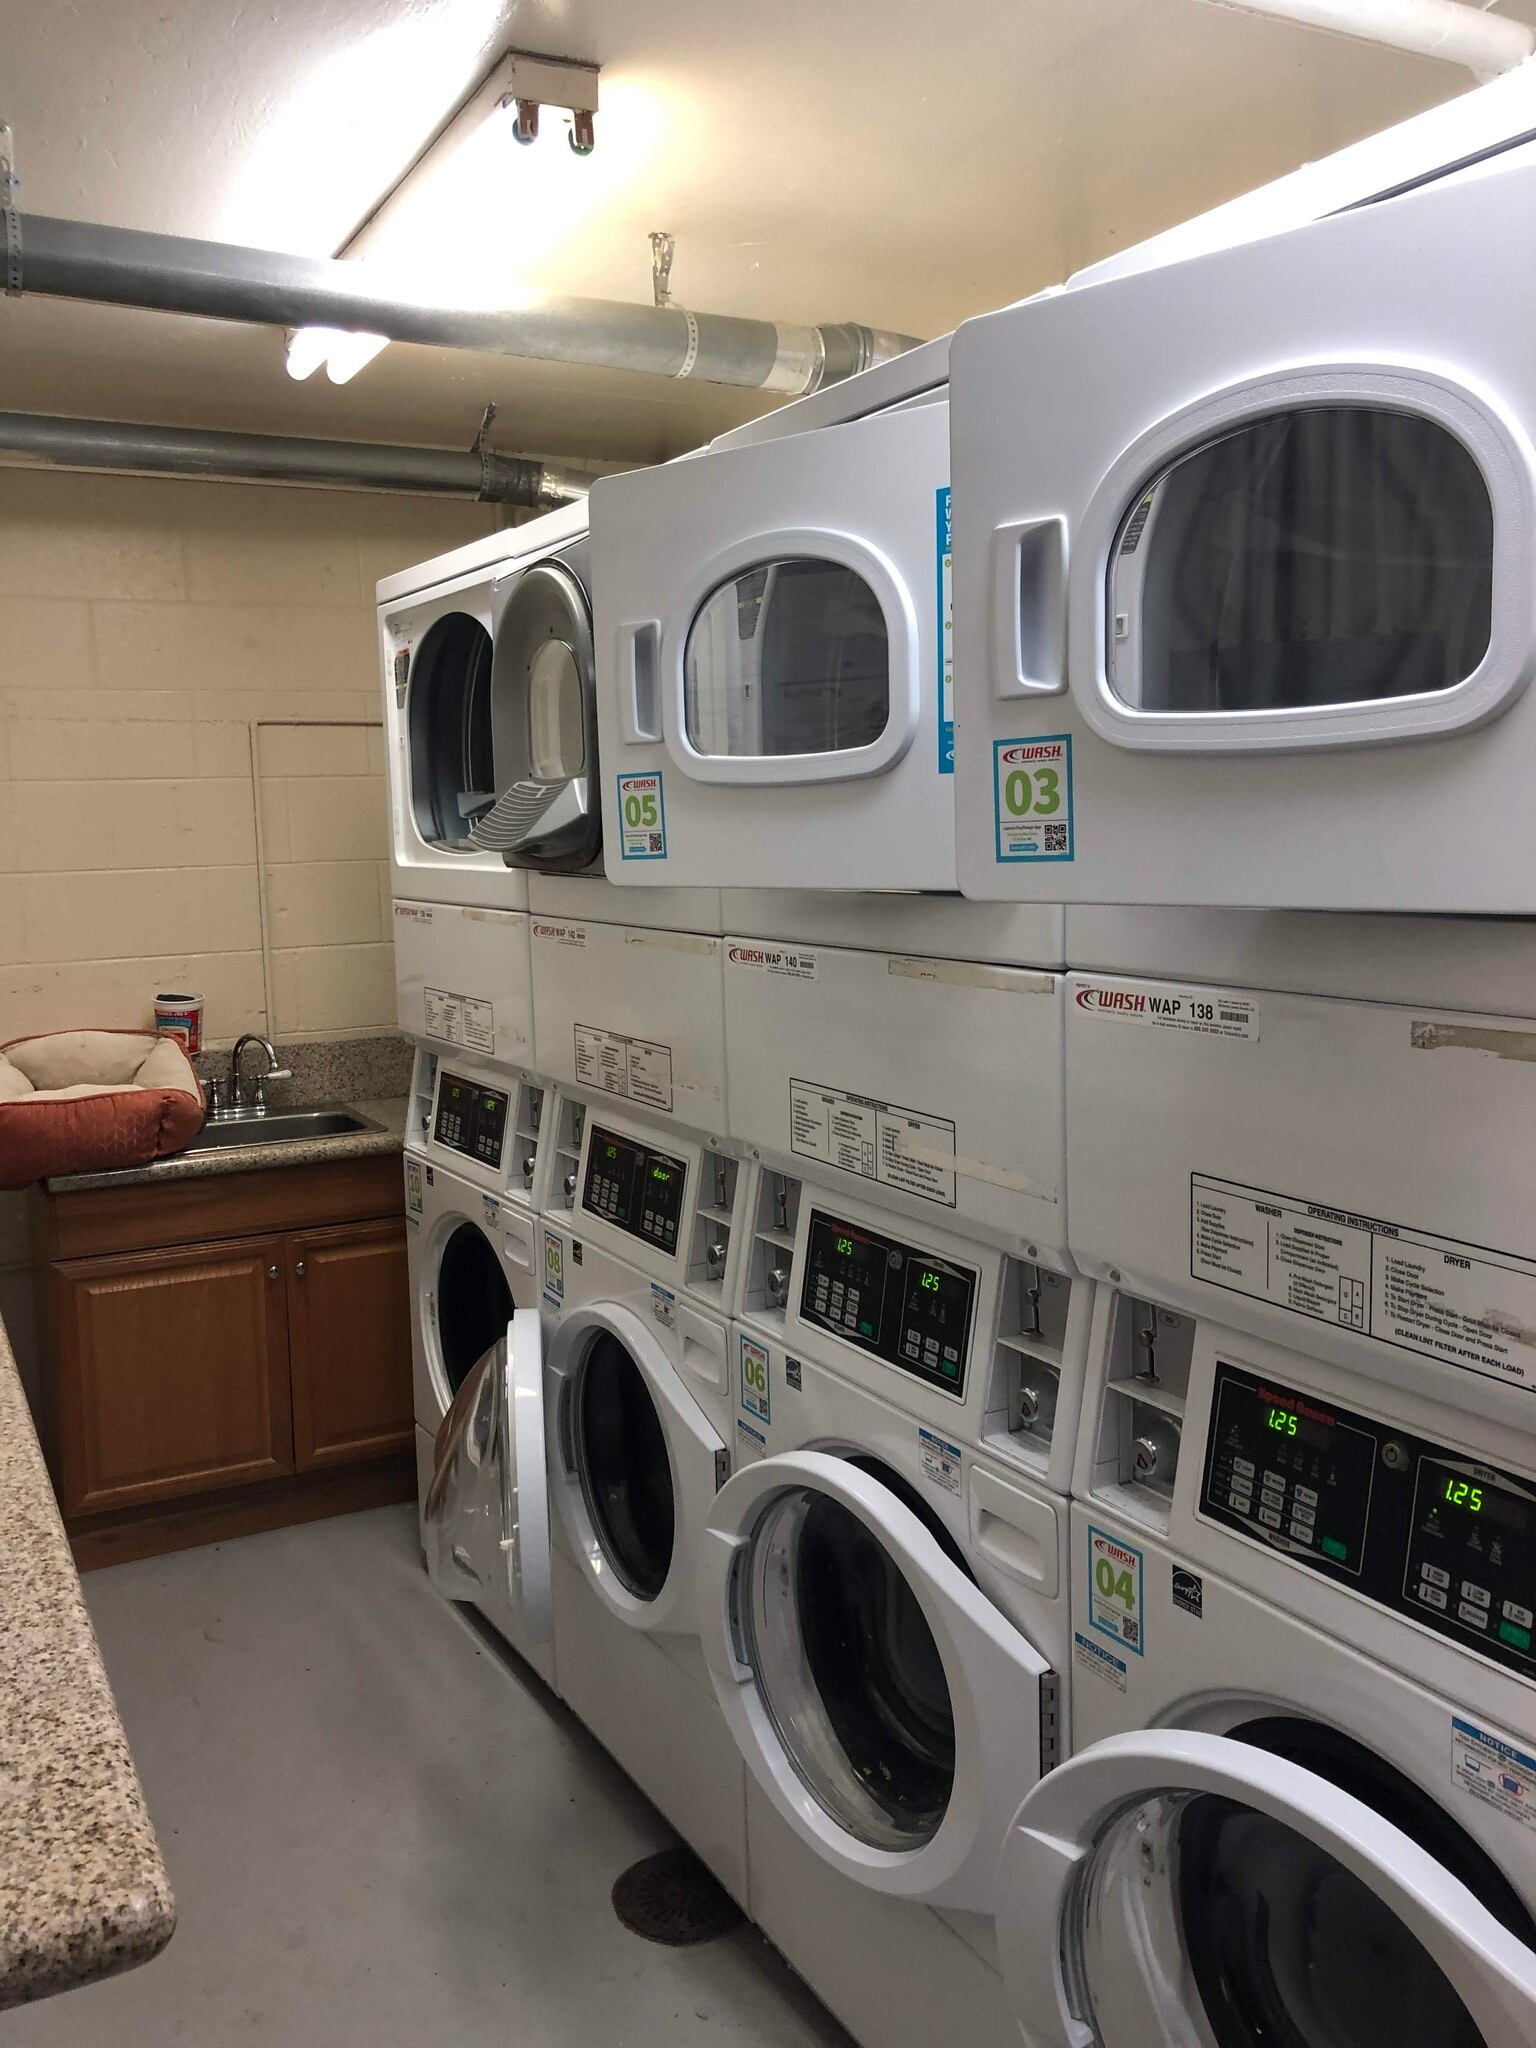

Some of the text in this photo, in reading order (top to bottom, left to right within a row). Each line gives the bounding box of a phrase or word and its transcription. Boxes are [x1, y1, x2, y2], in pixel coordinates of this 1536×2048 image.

[1022, 746, 1061, 760] WASH
[633, 779, 656, 789] WASH
[1005, 768, 1060, 816] 03
[625, 795, 657, 827] 05
[541, 926, 555, 936] WASH
[740, 949, 763, 963] WASH
[765, 953, 781, 965] WAP
[785, 956, 797, 967] 140
[1099, 991, 1145, 1011] WASH
[1149, 997, 1180, 1015] WAP
[1189, 1002, 1213, 1020] 138
[653, 1167, 670, 1181] door
[410, 1174, 419, 1195] 10
[1255, 1204, 1282, 1218] WASHER
[1308, 1206, 1399, 1236] OPERATING INSTRUCTIONS
[548, 1247, 560, 1274] 08
[1391, 1258, 1404, 1266] Load
[1404, 1261, 1426, 1273] Laundry
[1444, 1255, 1470, 1270] DRYER
[1390, 1267, 1405, 1276] Close
[1406, 1271, 1419, 1279] Door
[1390, 1276, 1404, 1284] Make
[1406, 1280, 1419, 1290] Cycle
[1420, 1284, 1445, 1296] Selection
[1390, 1285, 1404, 1294] Make
[1398, 1295, 1409, 1304] Start
[1411, 1298, 1424, 1309] Dryer
[1390, 1302, 1396, 1310] To
[1398, 1305, 1408, 1315] Stop
[1410, 1307, 1424, 1319] Dryer
[1425, 1313, 1442, 1325] During
[1443, 1317, 1458, 1329] Cycle
[1462, 1325, 1478, 1335] Open
[1479, 1330, 1492, 1339] Door
[1397, 1314, 1416, 1324] Restart
[1416, 1319, 1431, 1330] Dryer
[1434, 1325, 1450, 1336] Close
[1451, 1330, 1464, 1340] Door
[1465, 1335, 1476, 1344] and
[1477, 1338, 1493, 1350] Press
[1494, 1344, 1508, 1354] Start
[1394, 1328, 1524, 1377] (CLEAN LINT FILTER AFTER EACH LOAD)
[744, 1357, 765, 1392] 06
[1473, 1466, 1496, 1482] DRYER
[1268, 1531, 1290, 1548] WASHER
[1107, 1545, 1136, 1566] WASH
[1096, 1558, 1136, 1611] 04
[1082, 1636, 1120, 1668] NOTICE
[1480, 1733, 1518, 1759] NOTICE
